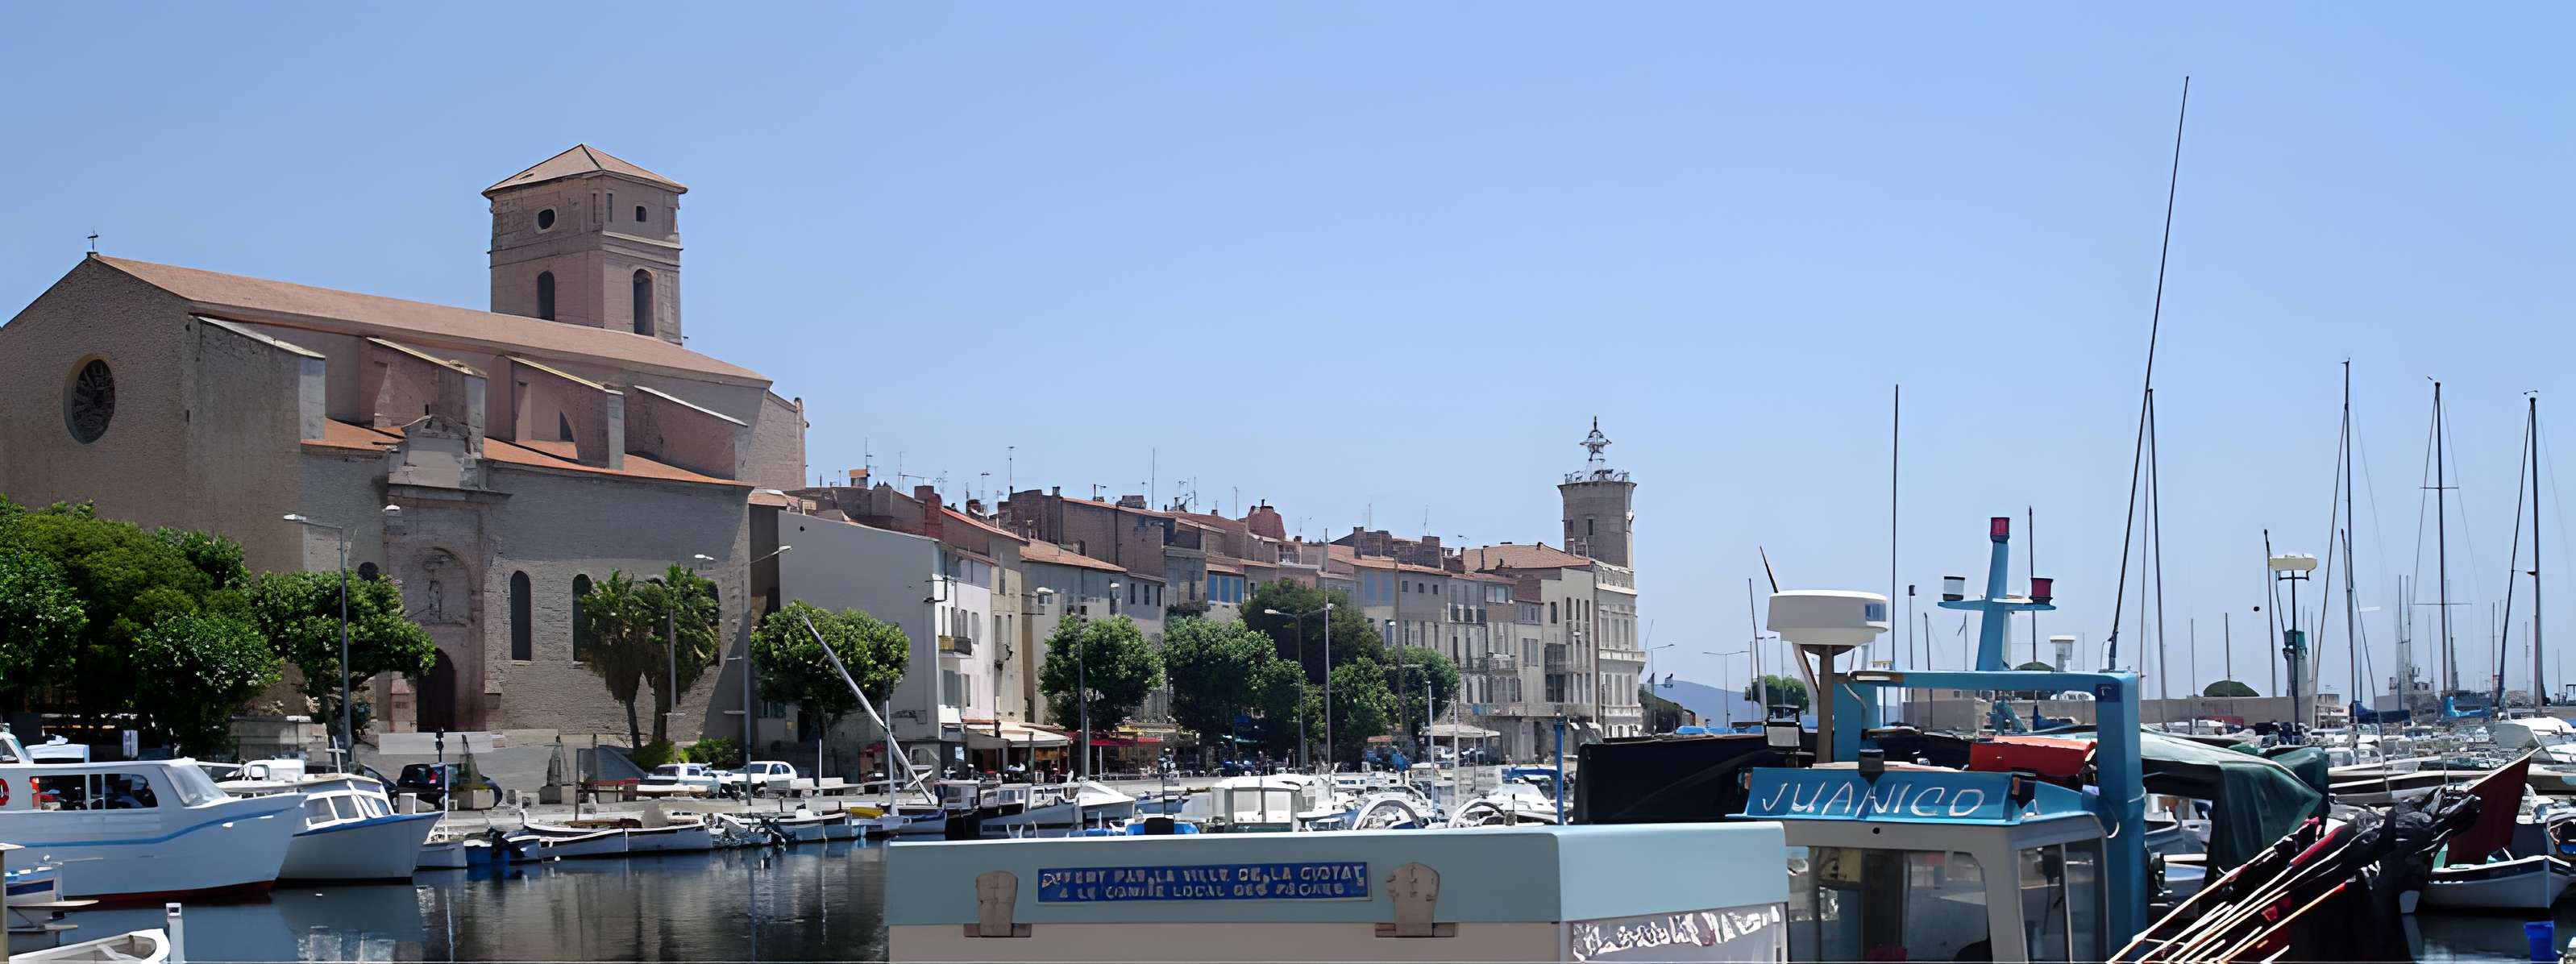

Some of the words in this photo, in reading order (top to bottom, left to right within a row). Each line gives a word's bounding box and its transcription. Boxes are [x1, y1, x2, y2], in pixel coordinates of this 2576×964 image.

[1762, 780, 1985, 818] JUANICO
[1270, 866, 1291, 881] LA
[1174, 885, 1225, 897] LOCAL
